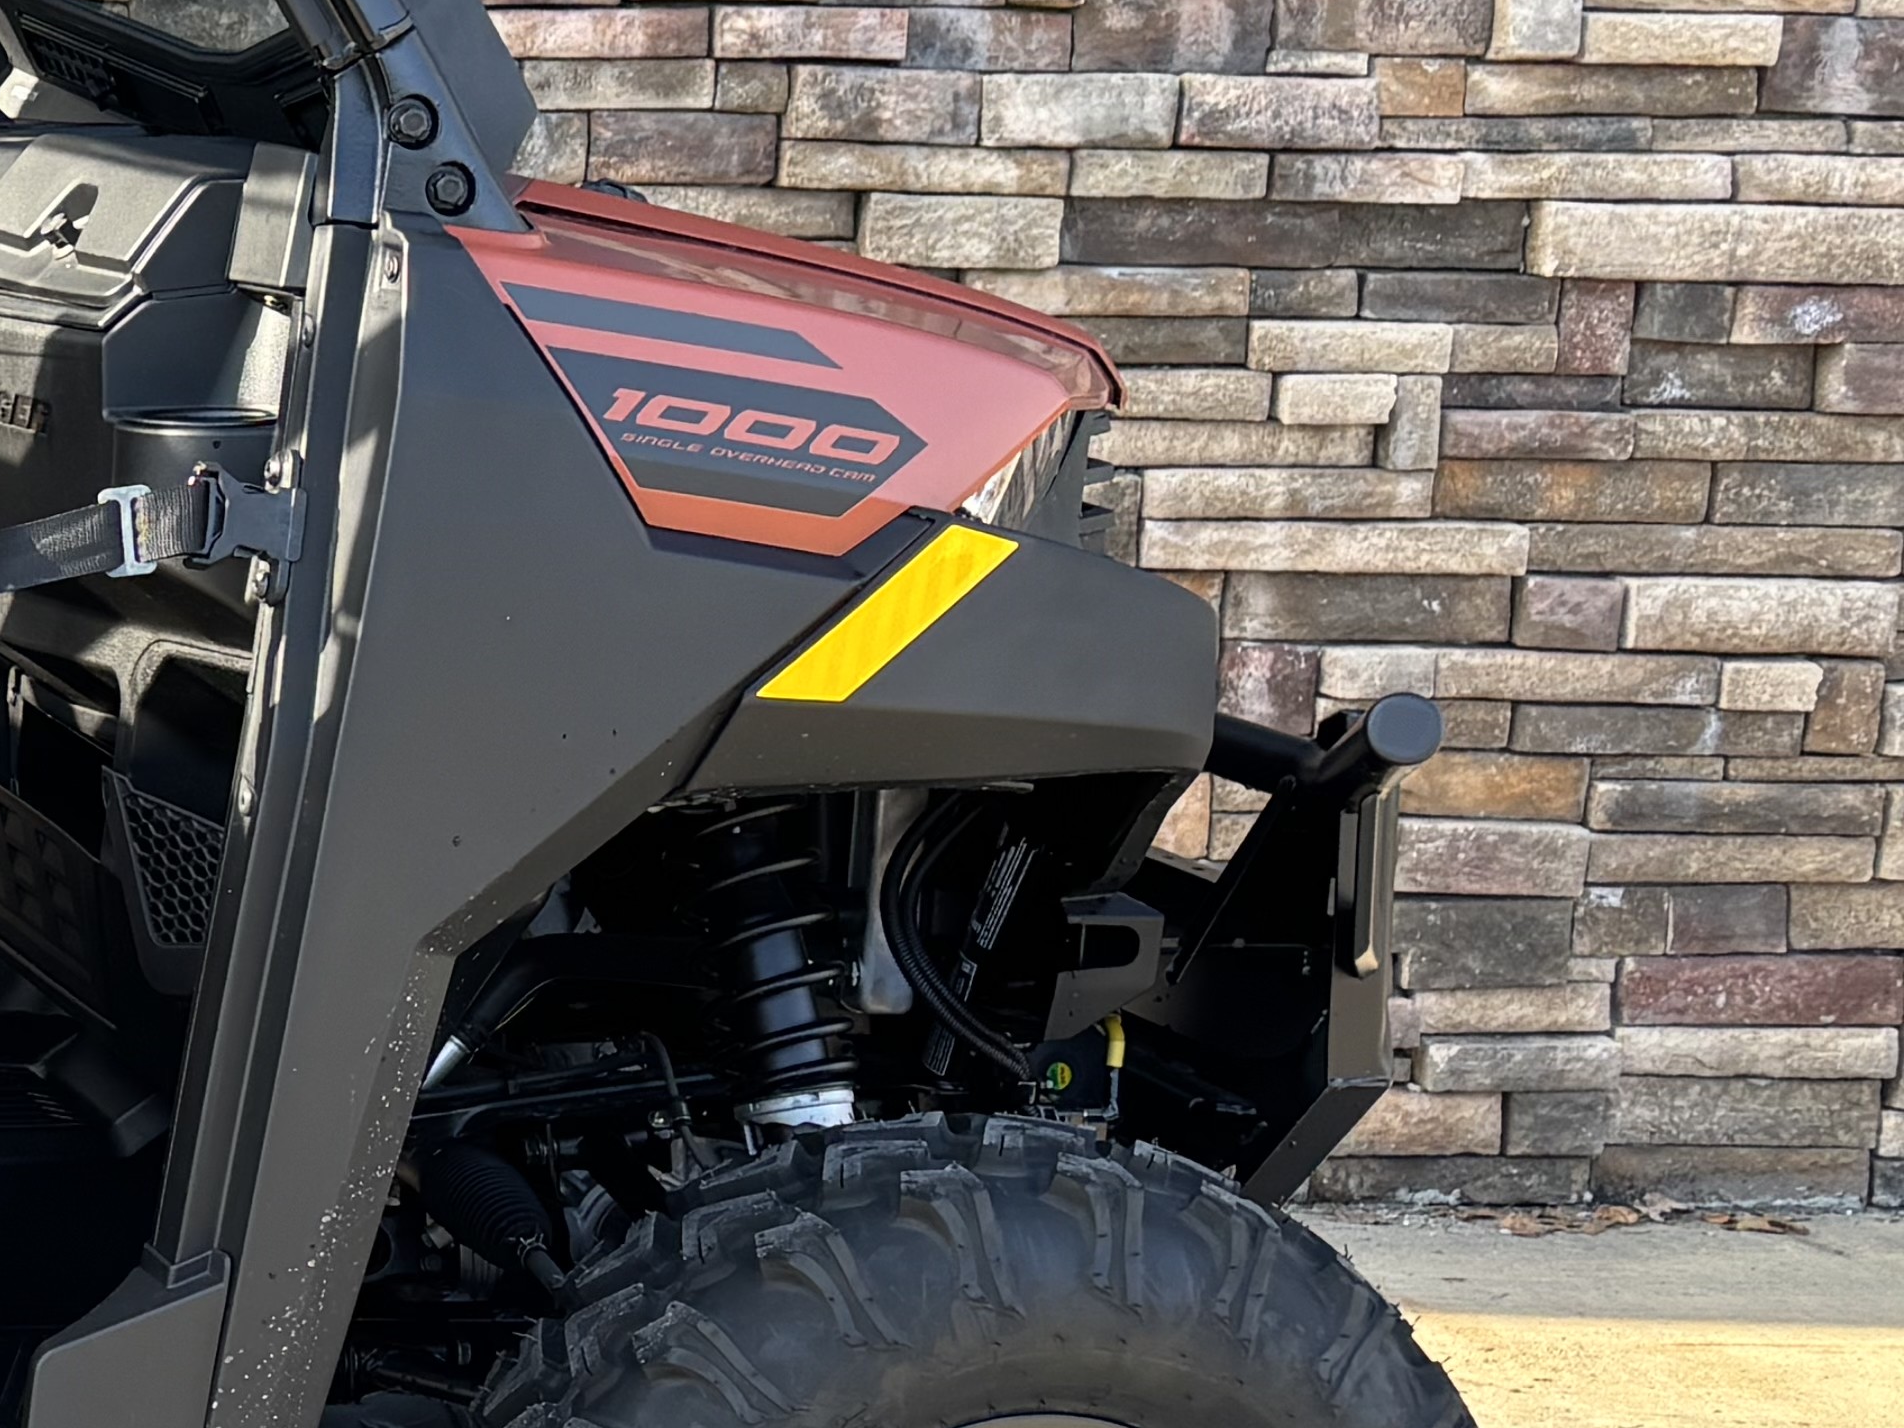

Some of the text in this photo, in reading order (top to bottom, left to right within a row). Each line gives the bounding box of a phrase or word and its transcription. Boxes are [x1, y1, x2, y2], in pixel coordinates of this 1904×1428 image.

[602, 387, 900, 466] 1000
[620, 431, 877, 484] SINGLE OVERHEAD CAM
